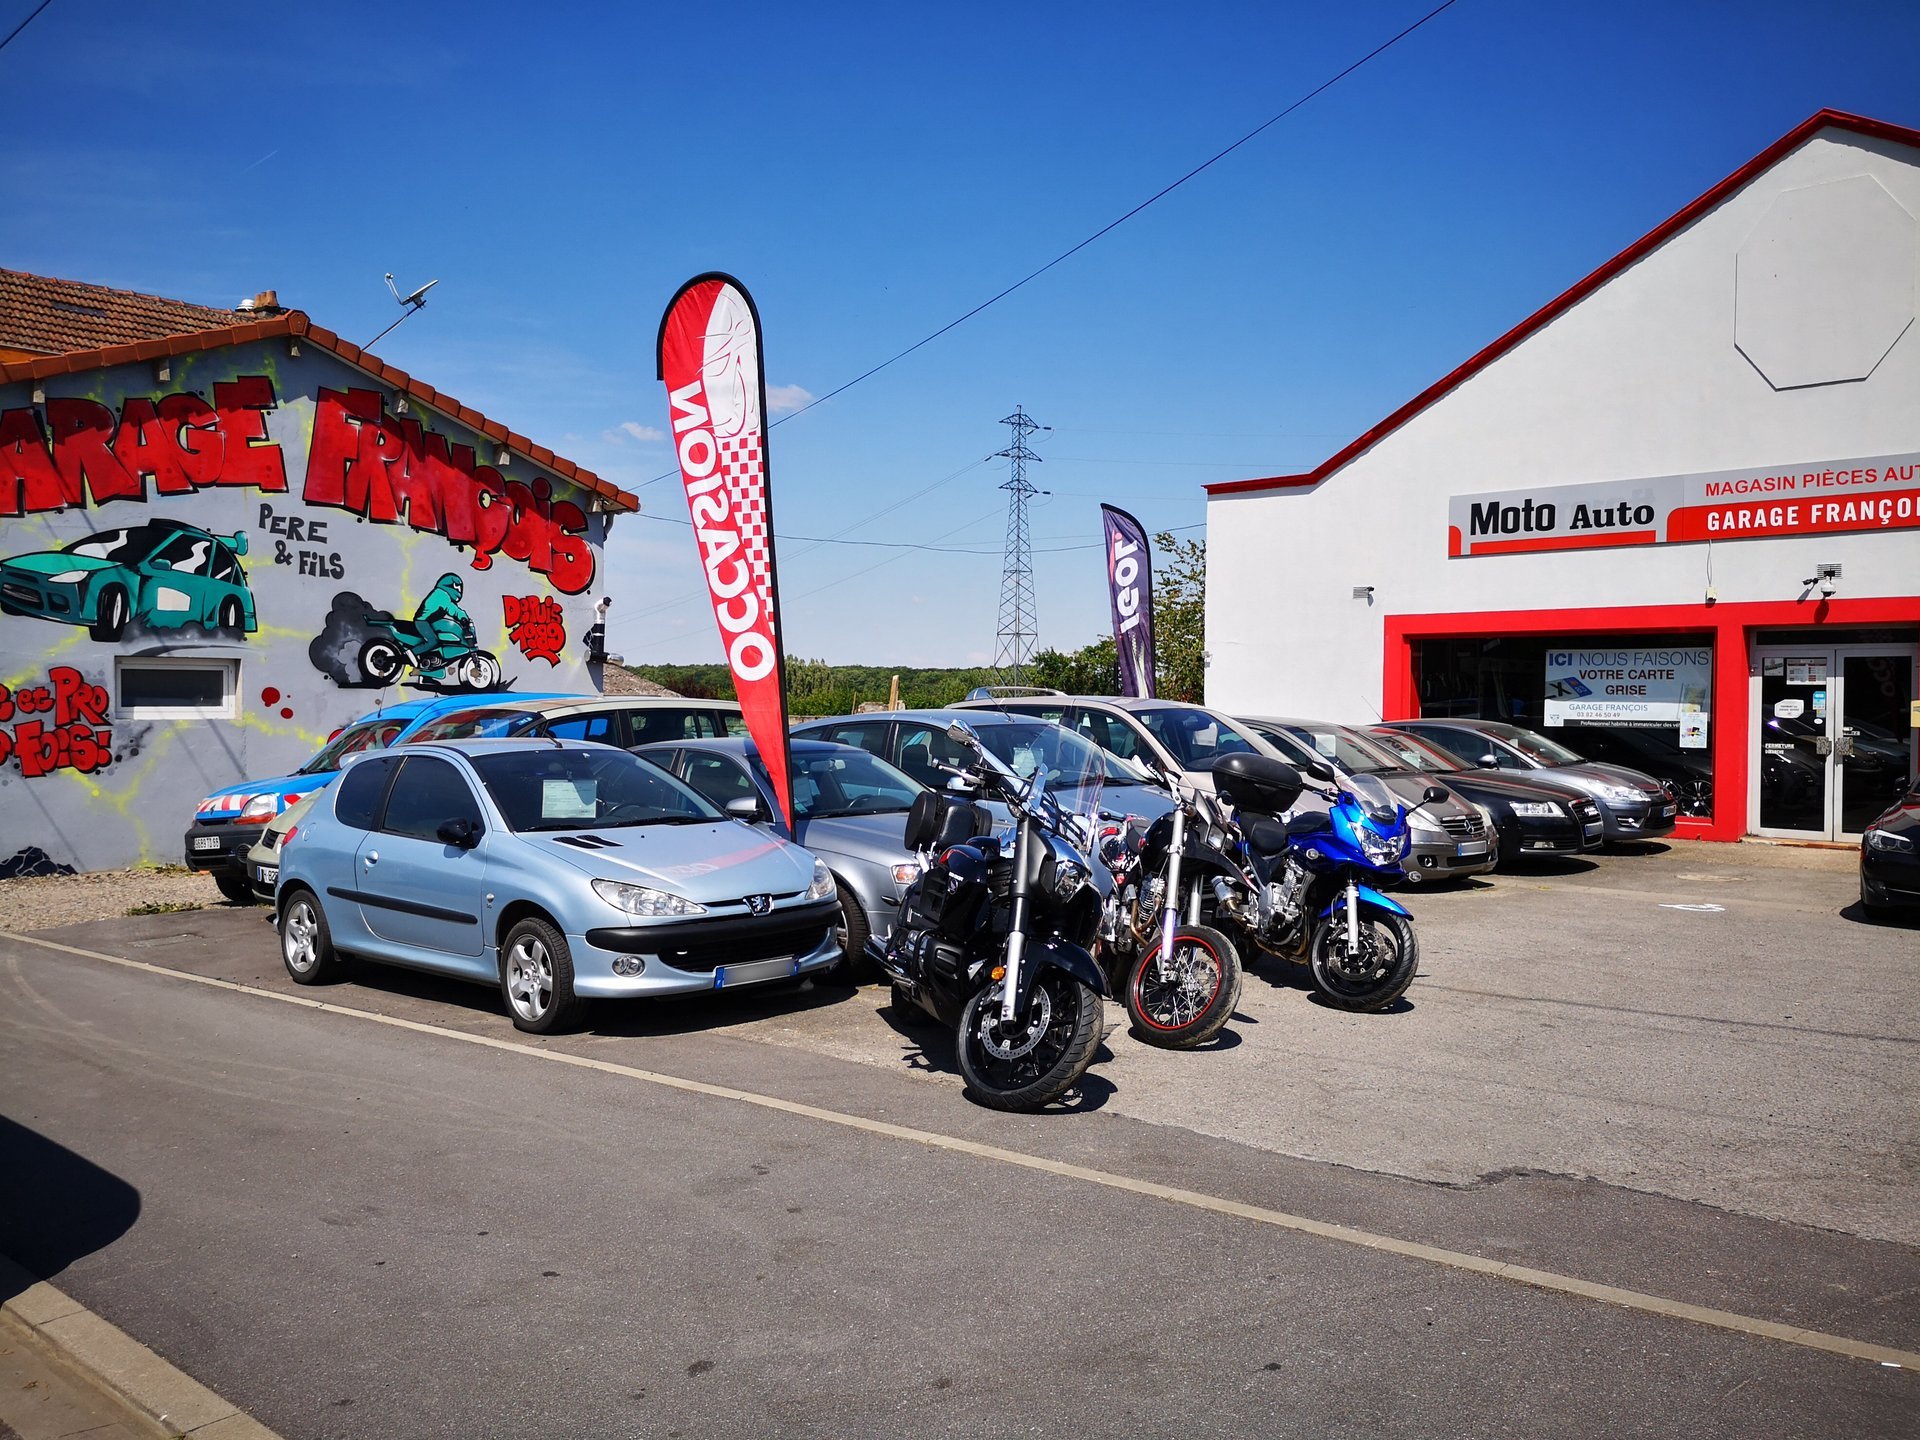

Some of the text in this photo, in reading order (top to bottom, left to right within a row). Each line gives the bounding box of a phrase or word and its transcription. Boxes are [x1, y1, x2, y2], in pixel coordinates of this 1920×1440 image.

[1705, 475, 1796, 497] MAGASIN
[1802, 469, 1878, 488] PIÈCES
[259, 503, 328, 544] PERE
[1470, 498, 1655, 536] Moto Auto
[1707, 505, 1800, 531] GARAGE
[274, 539, 294, 566] &
[508, 622, 567, 654] 1989
[1548, 651, 1709, 667] ICI NOUS FAISONS
[1579, 669, 1675, 680] VOTRE CARTE
[16, 686, 56, 714] et
[1605, 684, 1647, 695] GRISE
[1569, 703, 1649, 713] GARAGE FRANÇOIS
